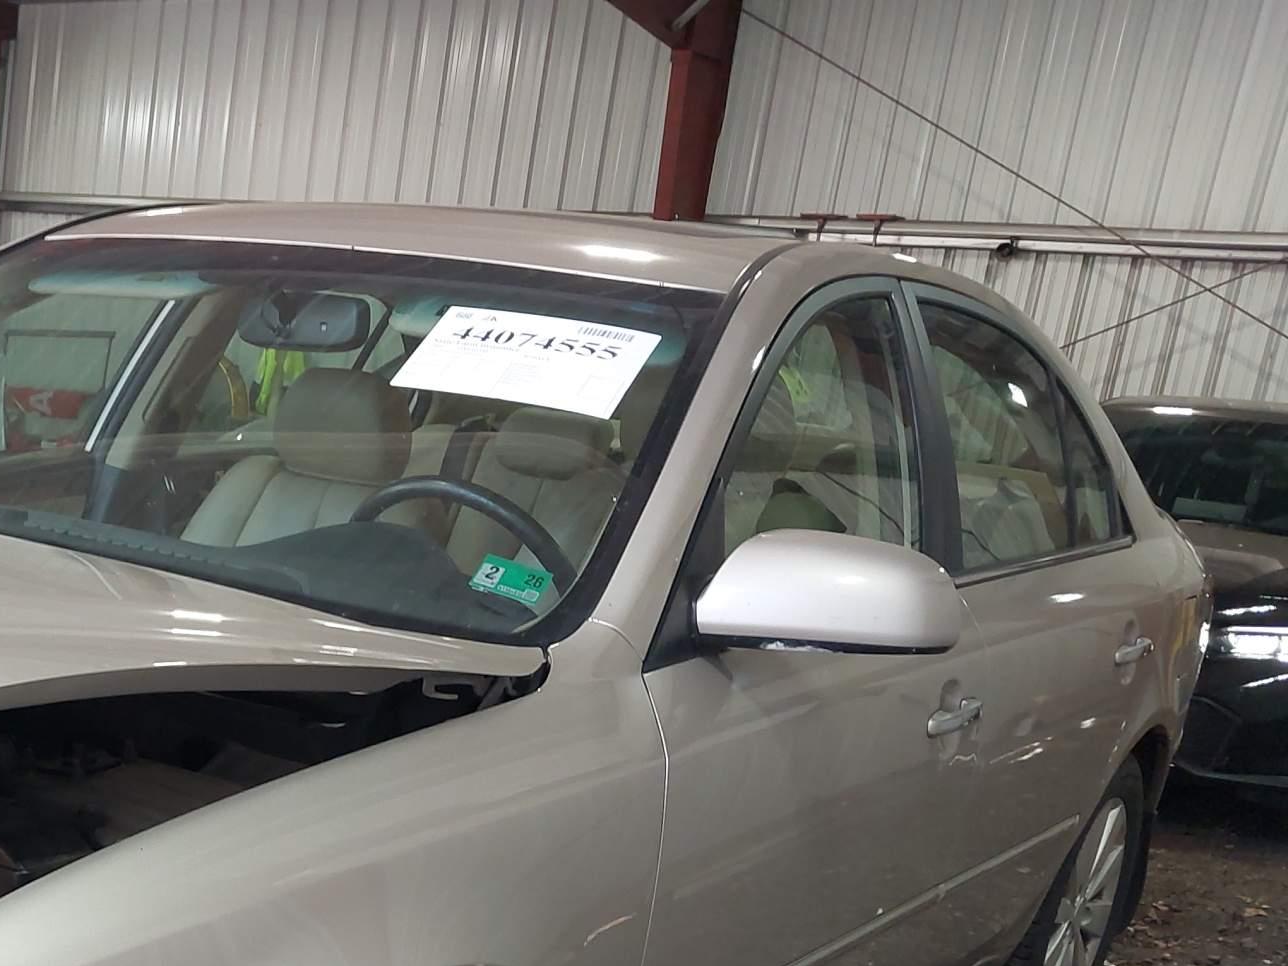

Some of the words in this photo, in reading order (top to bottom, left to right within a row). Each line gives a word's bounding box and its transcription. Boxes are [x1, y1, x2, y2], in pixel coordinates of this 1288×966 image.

[453, 326, 622, 360] 44074555
[485, 566, 500, 580] 2
[524, 574, 544, 589] 26
